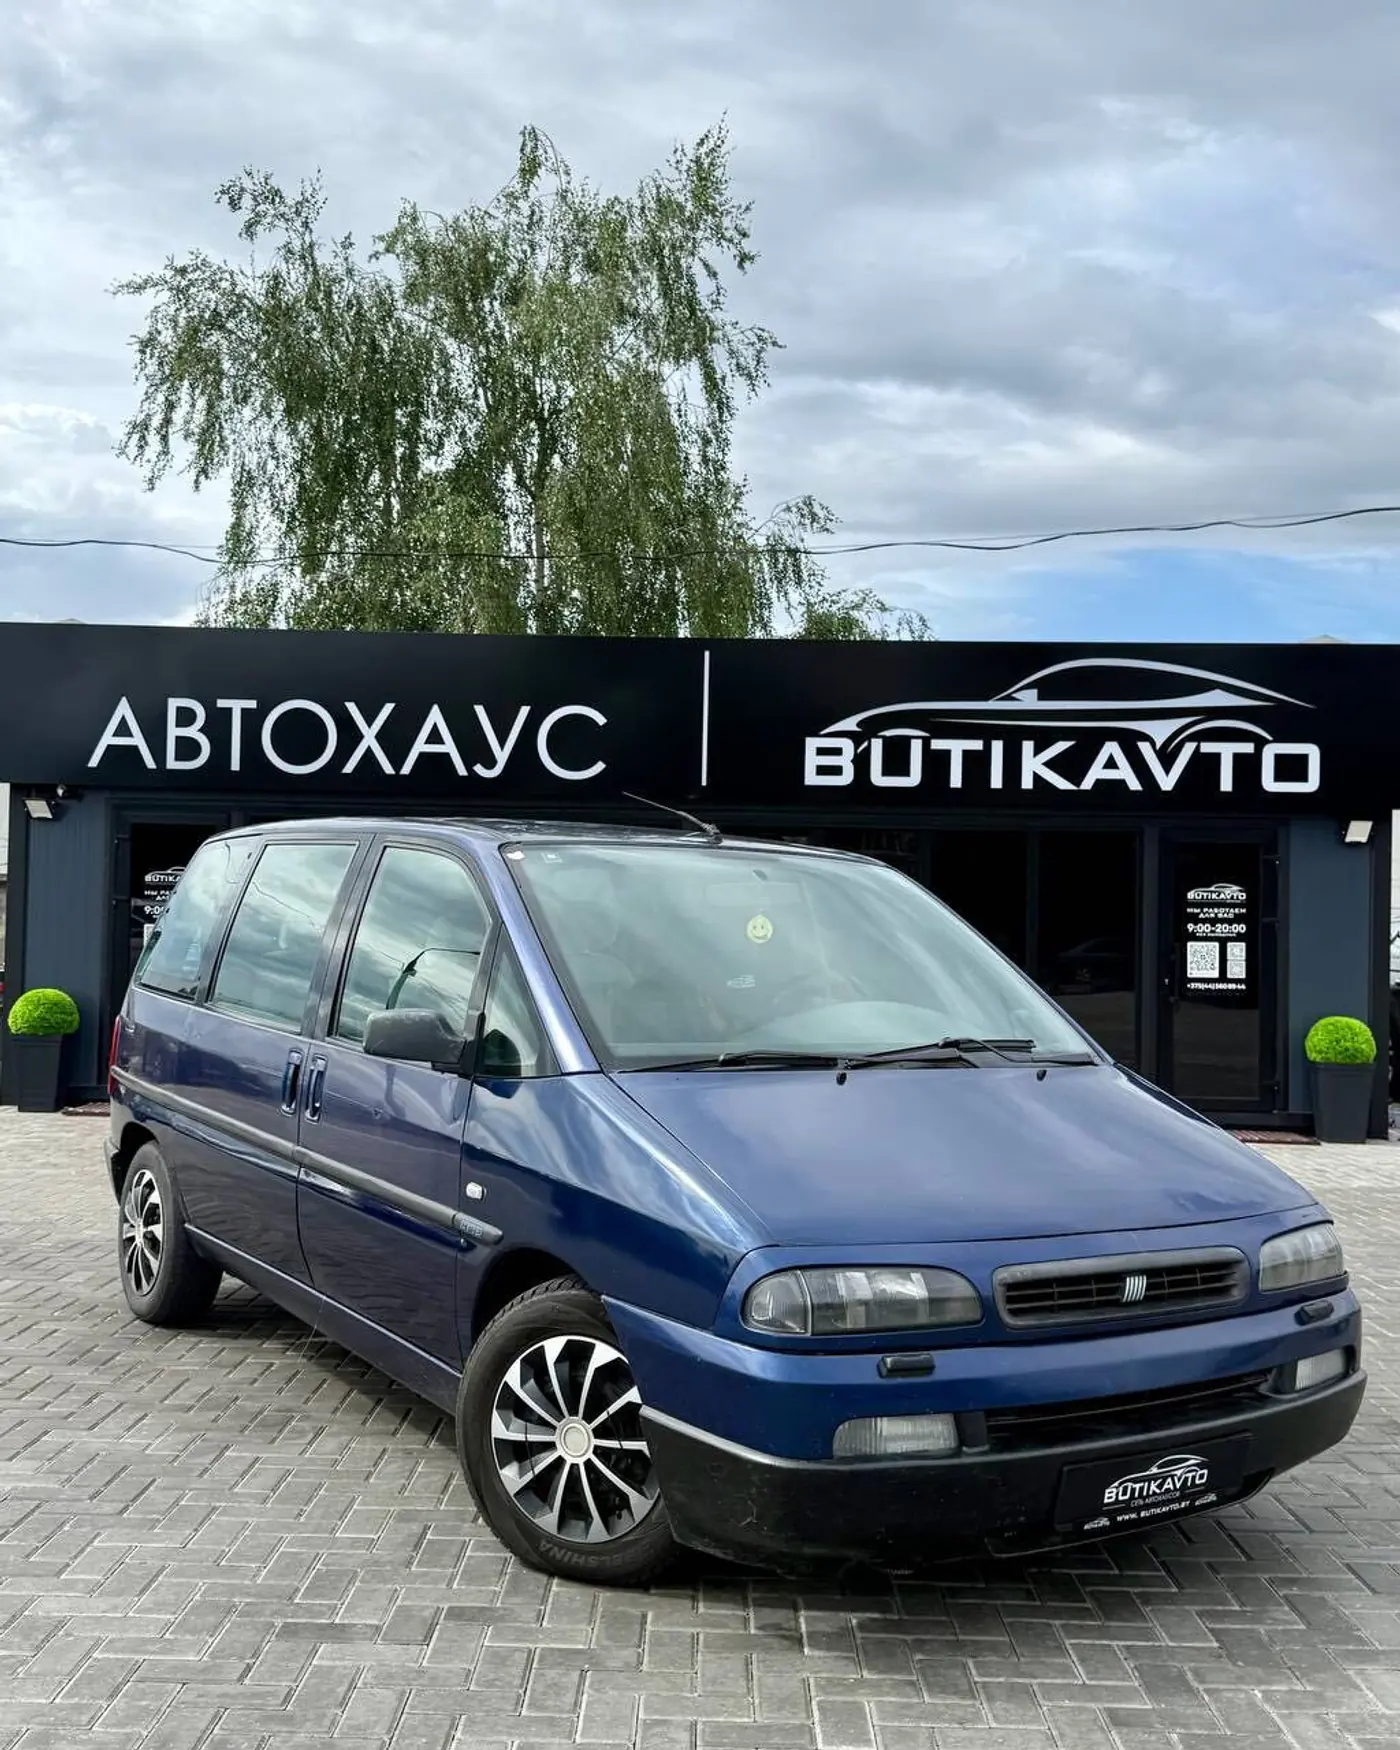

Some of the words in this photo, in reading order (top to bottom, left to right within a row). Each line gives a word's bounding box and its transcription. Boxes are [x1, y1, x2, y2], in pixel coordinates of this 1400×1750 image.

[87, 696, 608, 780] АВТОХАУС
[803, 736, 1321, 794] BUTIKAVTO
[1187, 892, 1246, 900] BUTIKAVTO
[1187, 923, 1246, 933] 9:00-20:00
[1103, 1469, 1208, 1504] BUTIKAVTO
